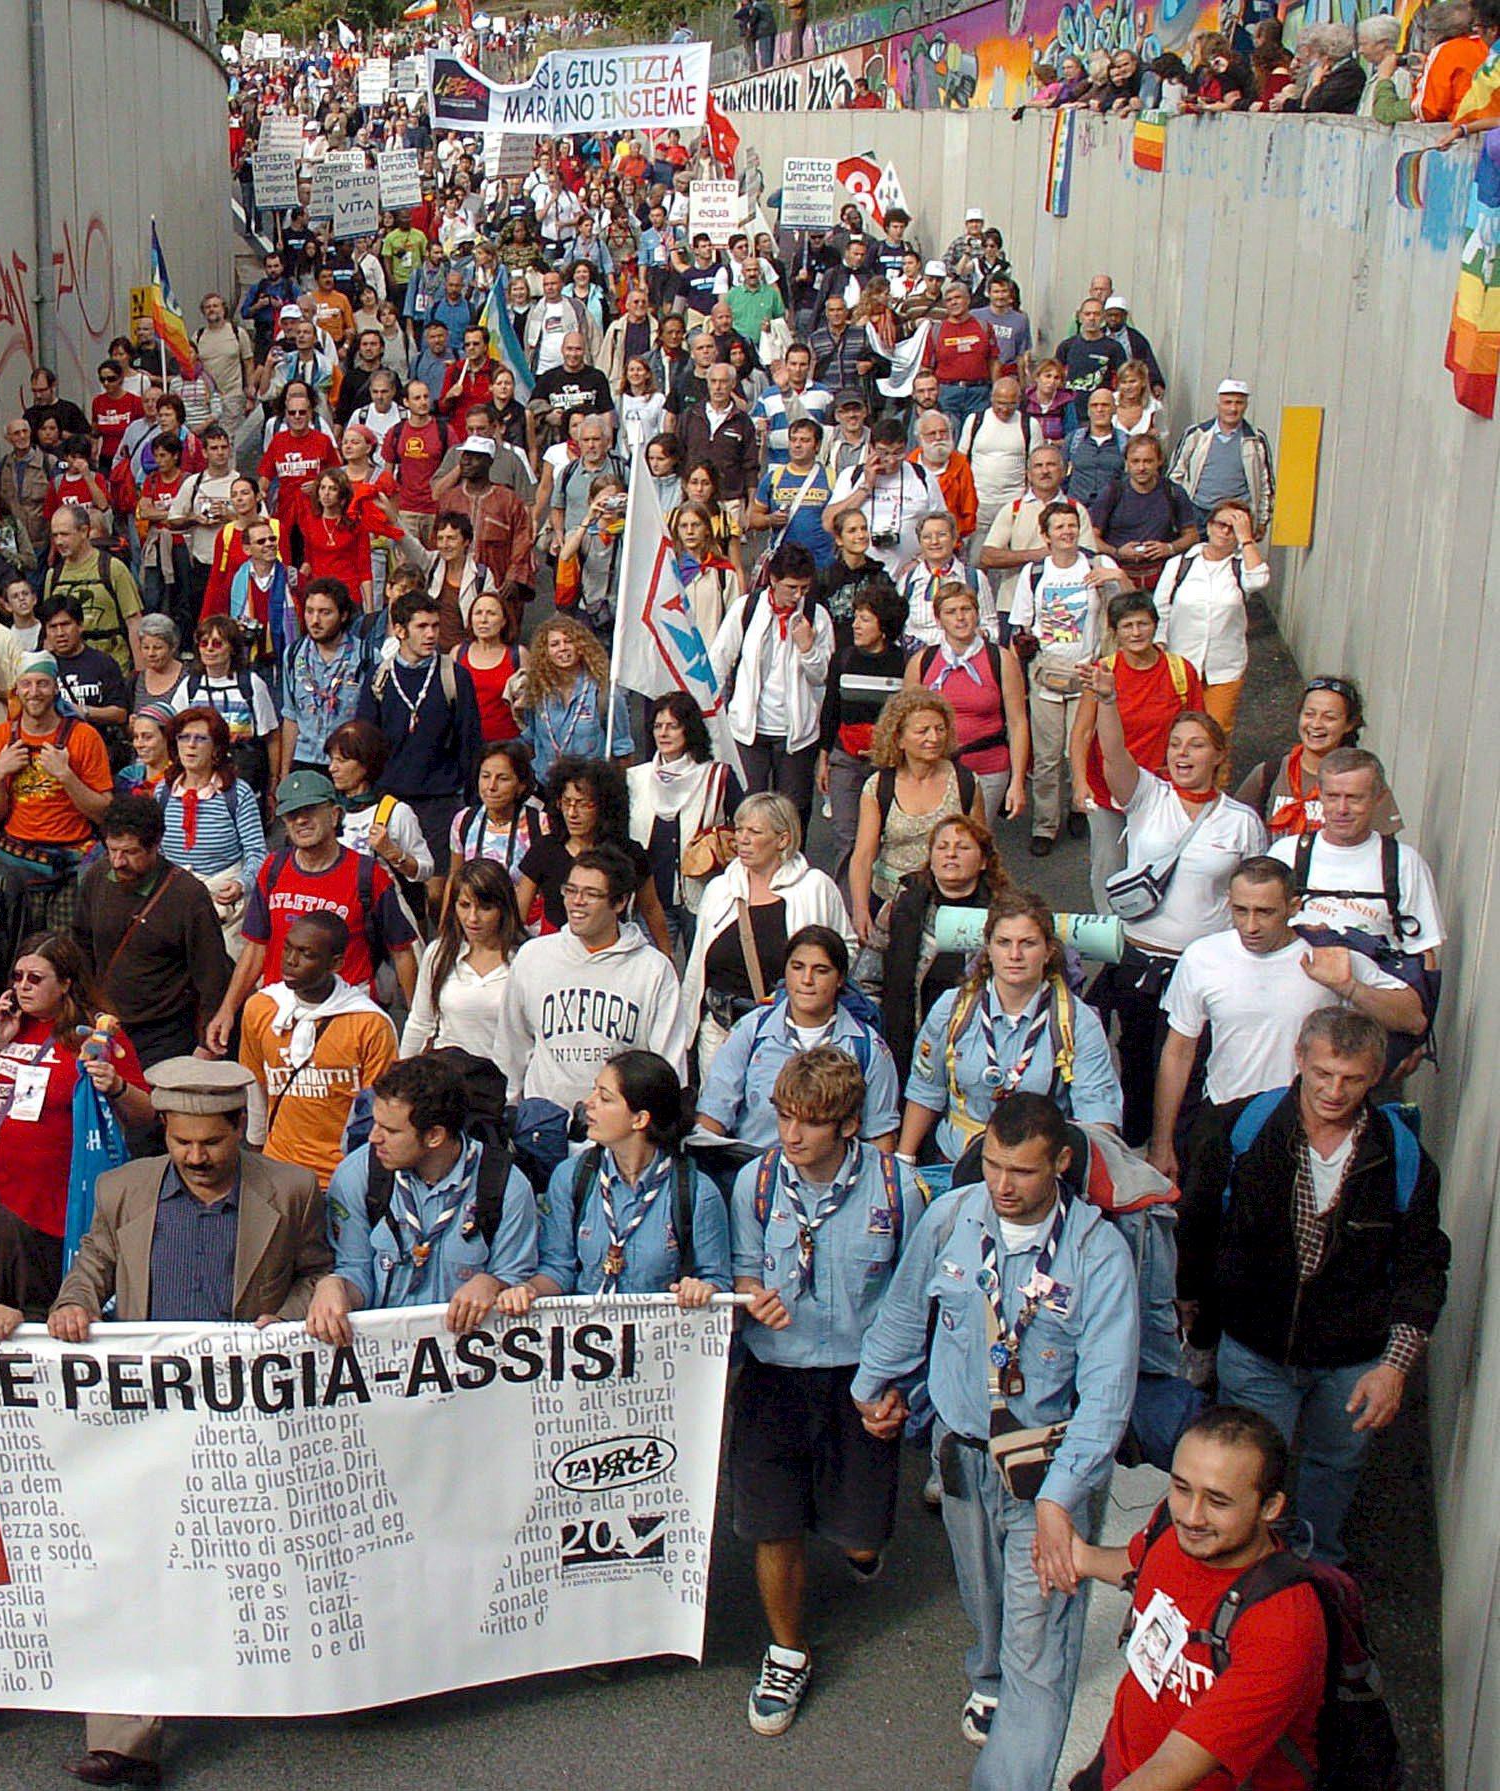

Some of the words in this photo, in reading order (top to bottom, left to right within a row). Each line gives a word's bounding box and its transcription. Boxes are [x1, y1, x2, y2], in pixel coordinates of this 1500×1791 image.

[566, 55, 684, 89] GIUSTIZIA
[601, 85, 697, 119] INSIEME
[788, 160, 831, 171] Diritto
[335, 176, 376, 189] Diritto
[692, 183, 736, 192] Diritto
[338, 200, 374, 213] VITA
[699, 208, 729, 220] equa
[542, 987, 640, 1045] OXFORD
[61, 1323, 636, 1413] PERUGIA-ASSISI
[278, 1414, 336, 1442] Diritto
[534, 1412, 618, 1437] ortunità.
[246, 1447, 281, 1467] alla
[290, 1439, 338, 1463] pace.
[212, 1468, 247, 1490] alla
[255, 1459, 341, 1493] giustizia.
[181, 1495, 279, 1515] sicurezza.
[287, 1483, 344, 1508] Diritto
[590, 1493, 625, 1513] alla
[192, 1515, 211, 1537] al
[216, 1515, 283, 1537] lavoro.
[290, 1503, 347, 1530] Diritto
[350, 1494, 367, 1517] al
[191, 1537, 251, 1559] Diritto
[258, 1536, 276, 1556] di
[353, 1515, 375, 1538] ad
[225, 1561, 281, 1583] svago
[239, 1602, 256, 1623] di
[488, 1587, 548, 1617] sonale
[329, 1611, 363, 1635] alla
[349, 1631, 366, 1650] di
